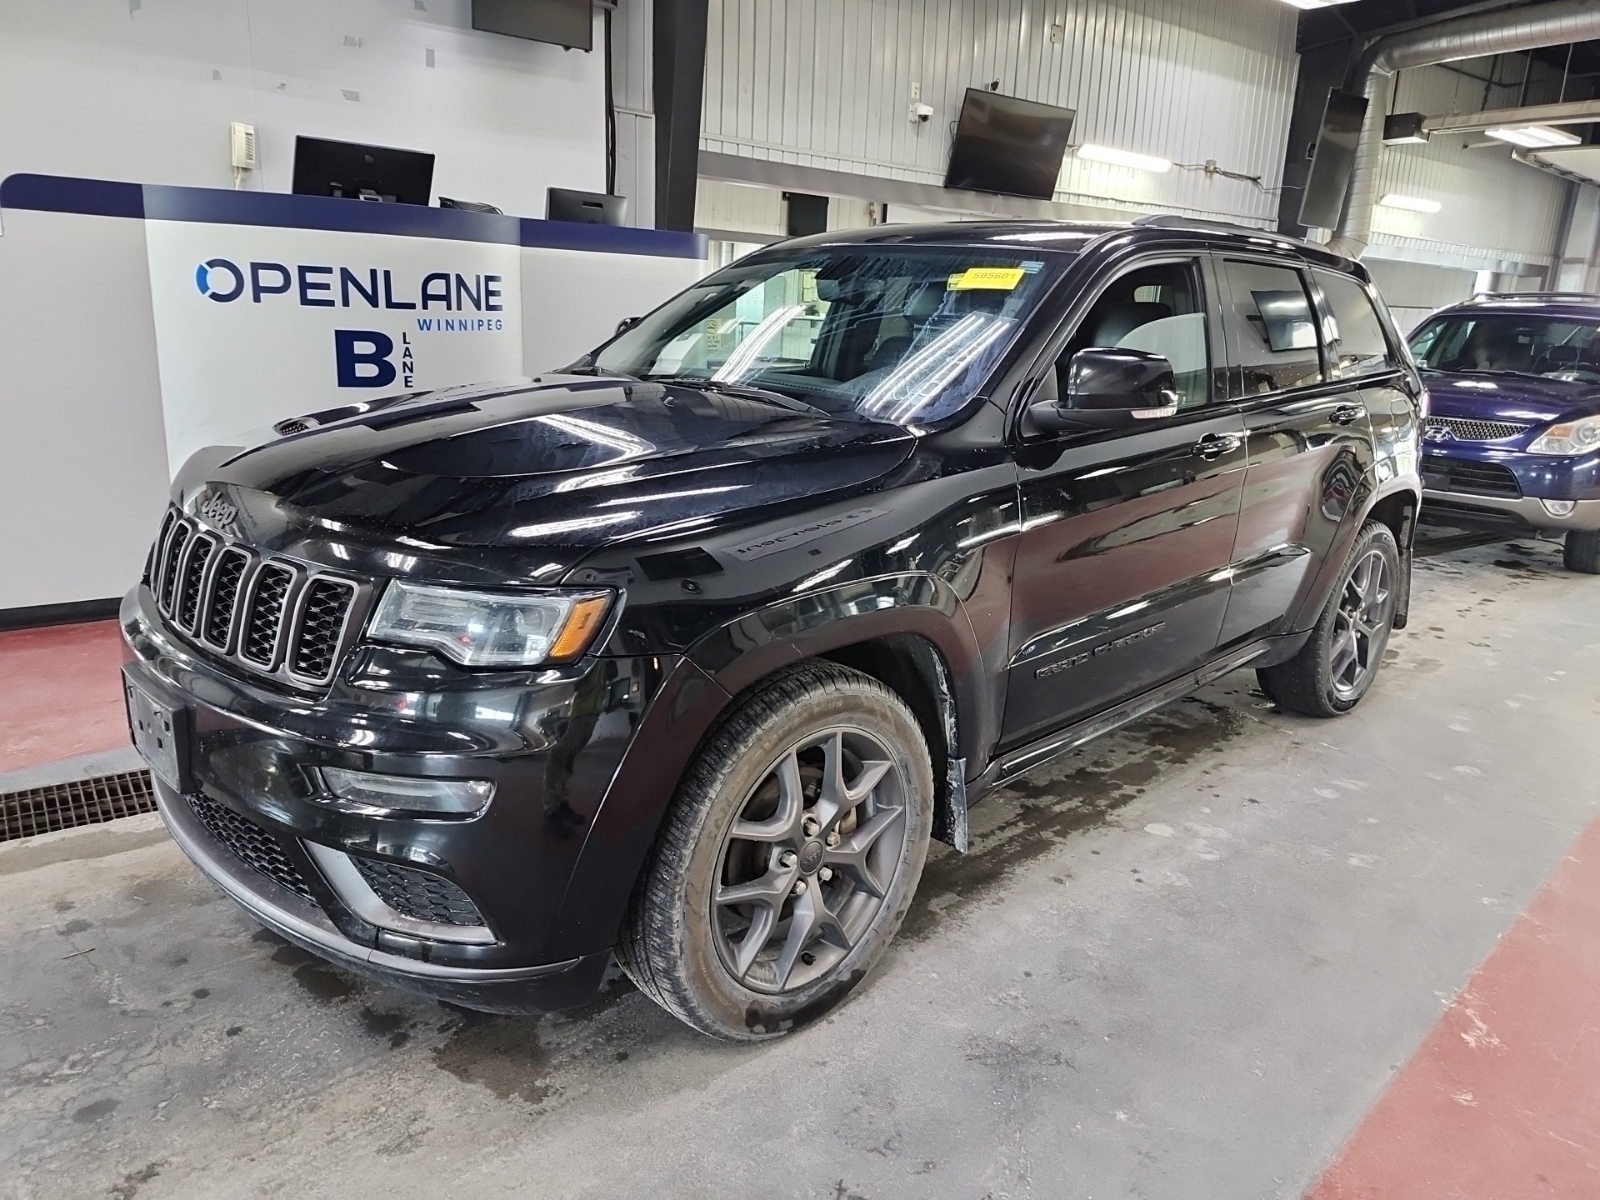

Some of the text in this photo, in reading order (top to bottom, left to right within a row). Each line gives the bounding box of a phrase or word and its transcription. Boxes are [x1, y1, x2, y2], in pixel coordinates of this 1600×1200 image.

[195, 258, 504, 312] OPENLANE
[973, 272, 1016, 280] 505601
[416, 318, 504, 332] WINNIPEG
[334, 329, 398, 389] B
[402, 332, 415, 389] LANE
[201, 491, 238, 529] Jeep
